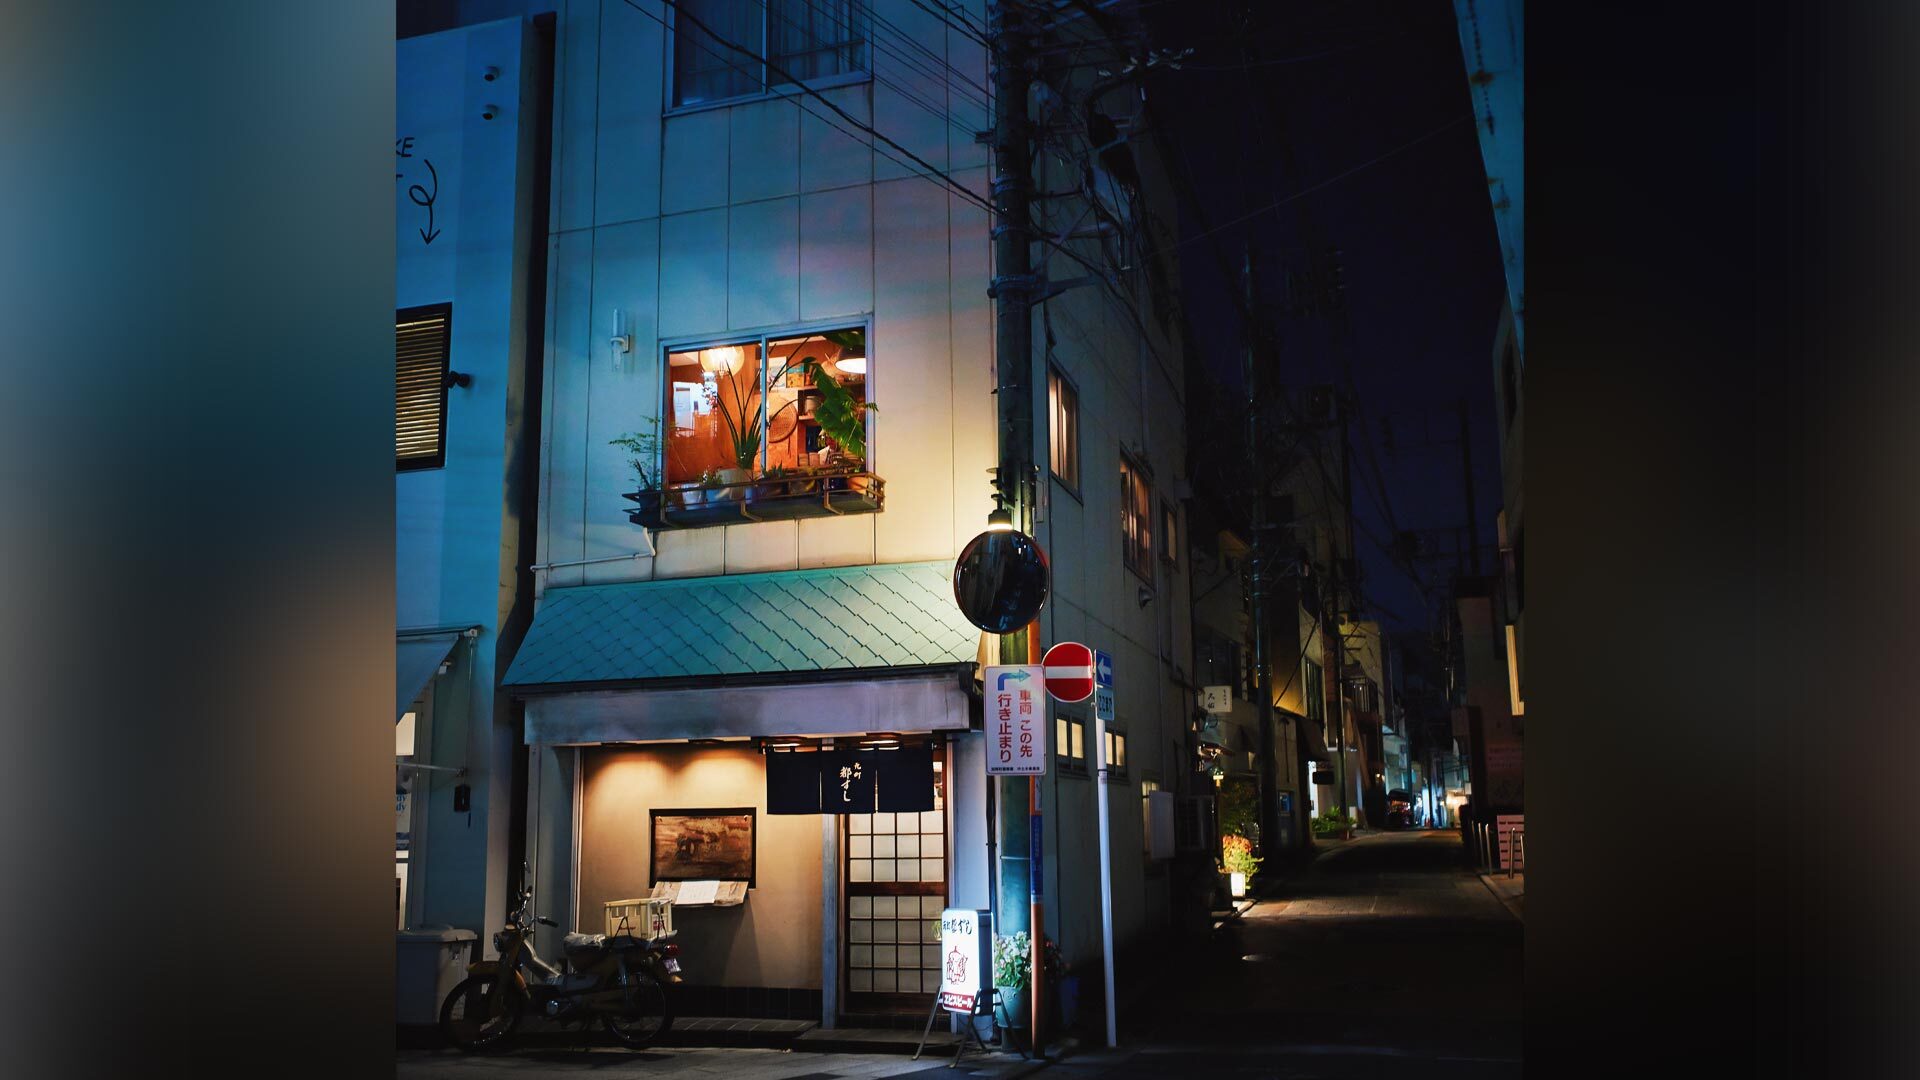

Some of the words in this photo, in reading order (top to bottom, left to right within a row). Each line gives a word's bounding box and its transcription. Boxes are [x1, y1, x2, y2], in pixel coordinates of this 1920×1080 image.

[1019, 689, 1032, 715] 車両
[997, 693, 1013, 763] 行き止まり
[1019, 719, 1033, 758] この先
